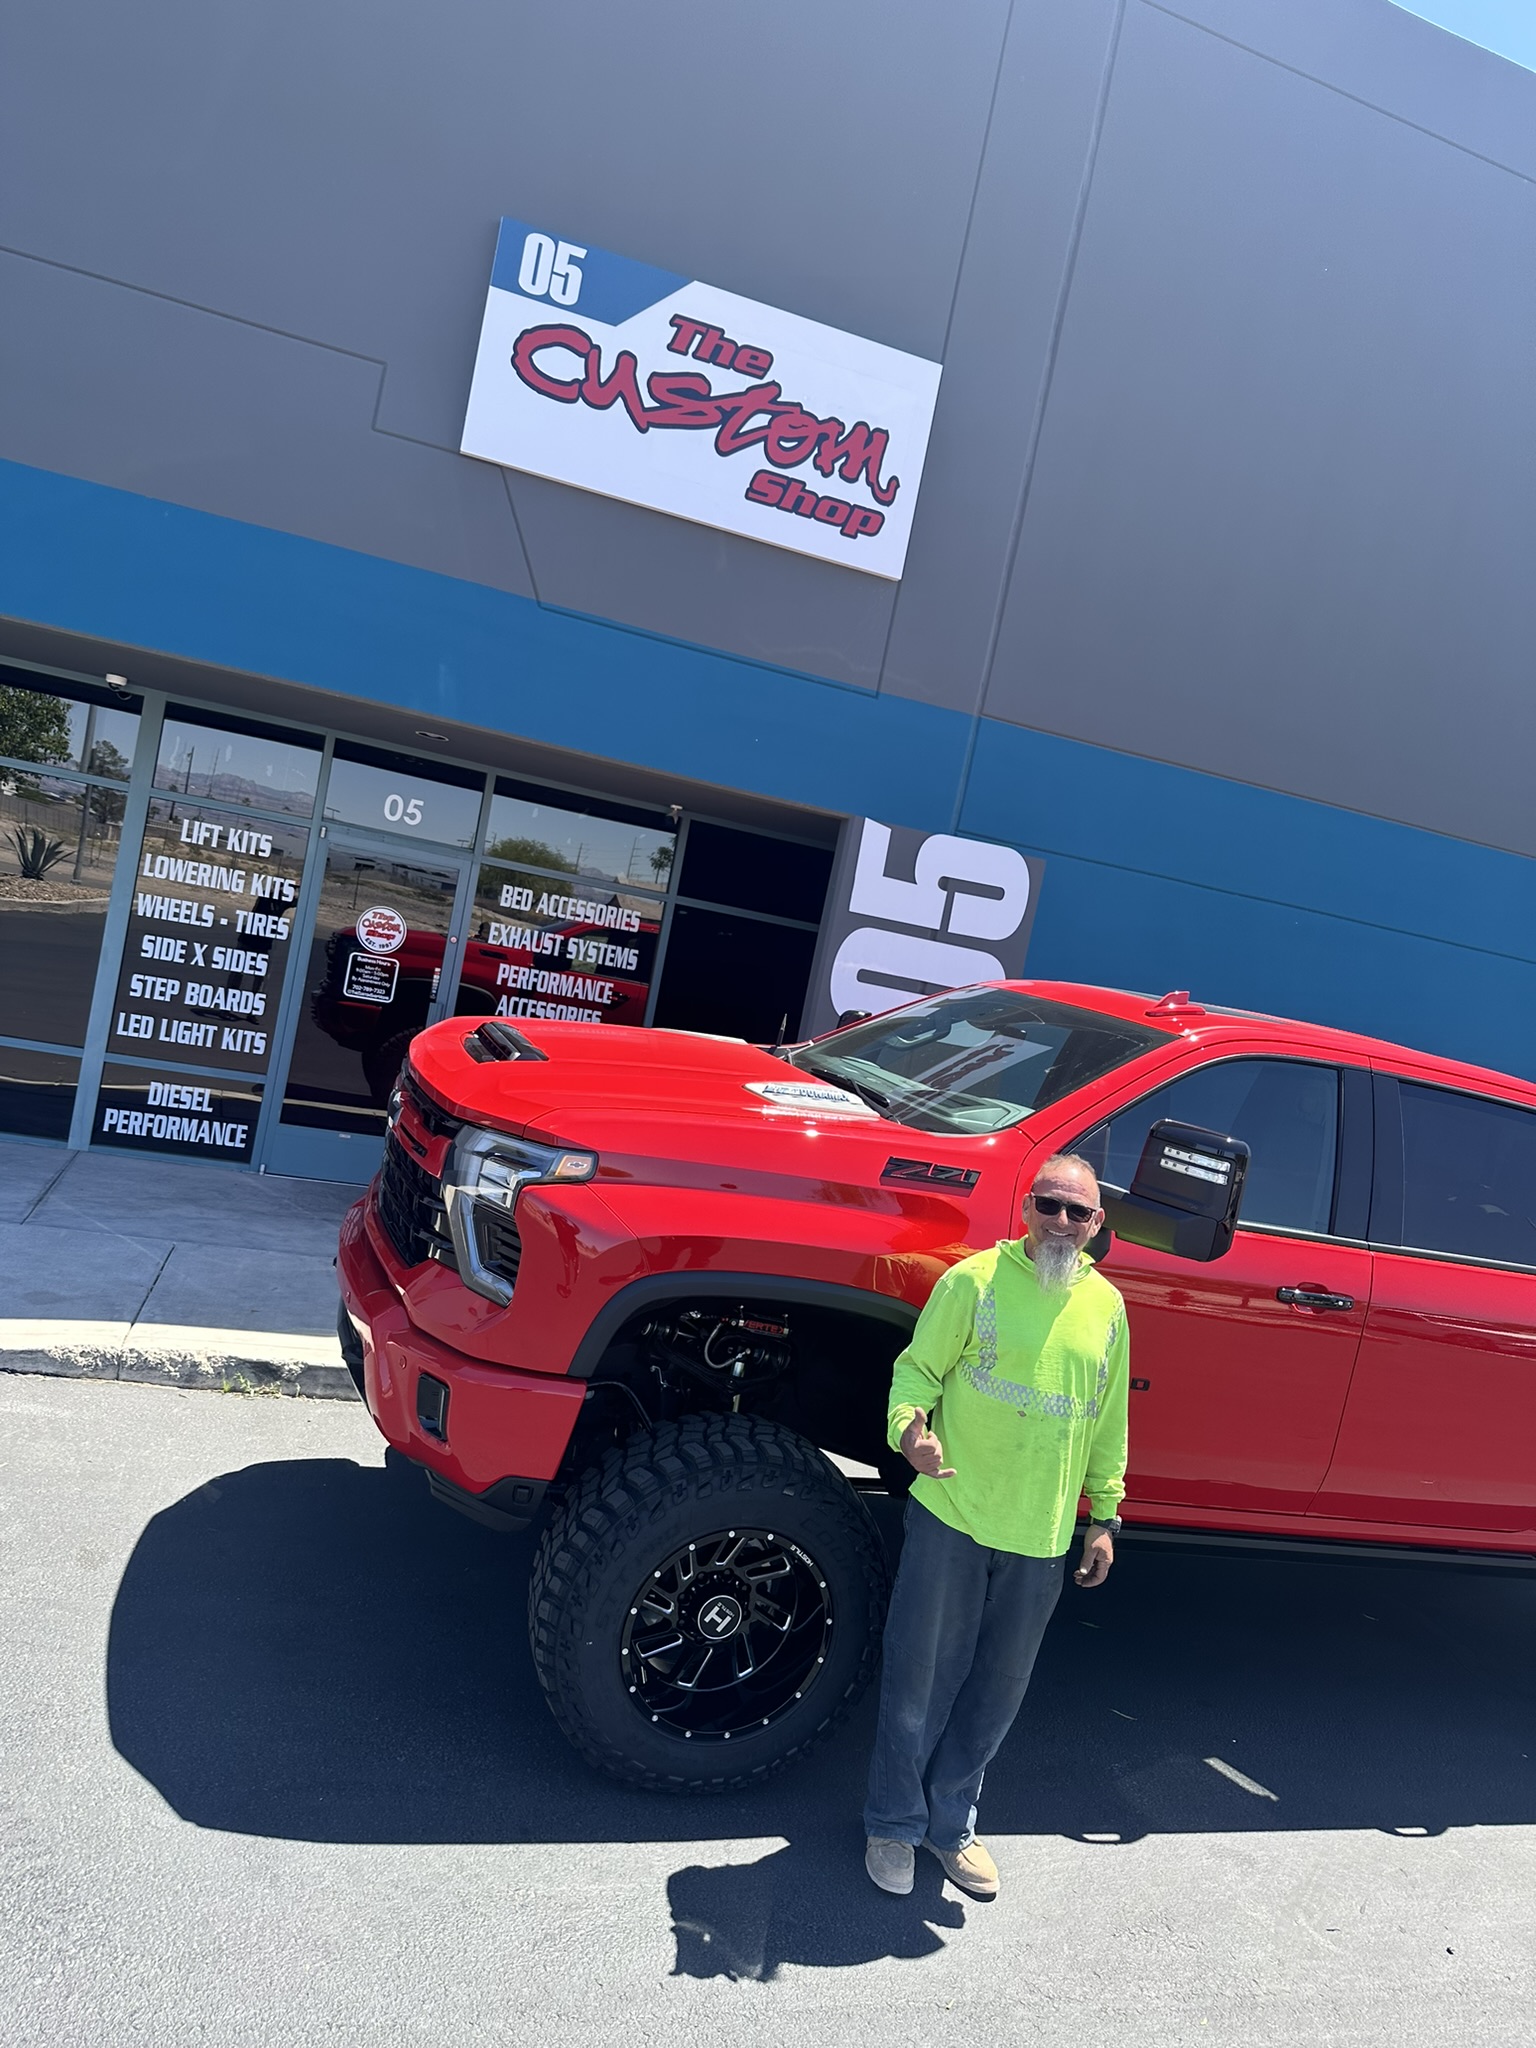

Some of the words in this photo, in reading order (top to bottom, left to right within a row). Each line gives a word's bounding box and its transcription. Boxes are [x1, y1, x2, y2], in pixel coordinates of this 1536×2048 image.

[518, 232, 588, 306] 05
[667, 313, 774, 380] The
[744, 468, 886, 539] Shop
[383, 793, 425, 826] 05
[180, 818, 223, 848] LIFT
[226, 827, 273, 858] KITS
[142, 852, 246, 894] LOWERING
[249, 872, 296, 902] KITS
[137, 892, 215, 927] WHEELS
[235, 909, 290, 940] TIRES
[500, 884, 533, 911] BED
[535, 892, 641, 932] ACCESSORIES
[830, 817, 1030, 1016] 05
[141, 934, 187, 963] SIDE
[190, 942, 208, 967] X
[211, 946, 269, 976] SIDES
[487, 922, 564, 956] EXHAUST
[566, 937, 638, 970] SYSTEMS
[129, 973, 180, 1002] STEP
[184, 982, 266, 1016] BOARDS
[496, 963, 614, 1004] PERFORMANCE
[495, 994, 602, 1023] ACCESSORIES
[116, 1012, 154, 1039] LED
[159, 1018, 218, 1047] LIGHT
[221, 1027, 267, 1055] KITS
[146, 1081, 213, 1113] DIESEL
[102, 1108, 248, 1148] PERFORMANCE
[881, 1156, 982, 1186] Z71
